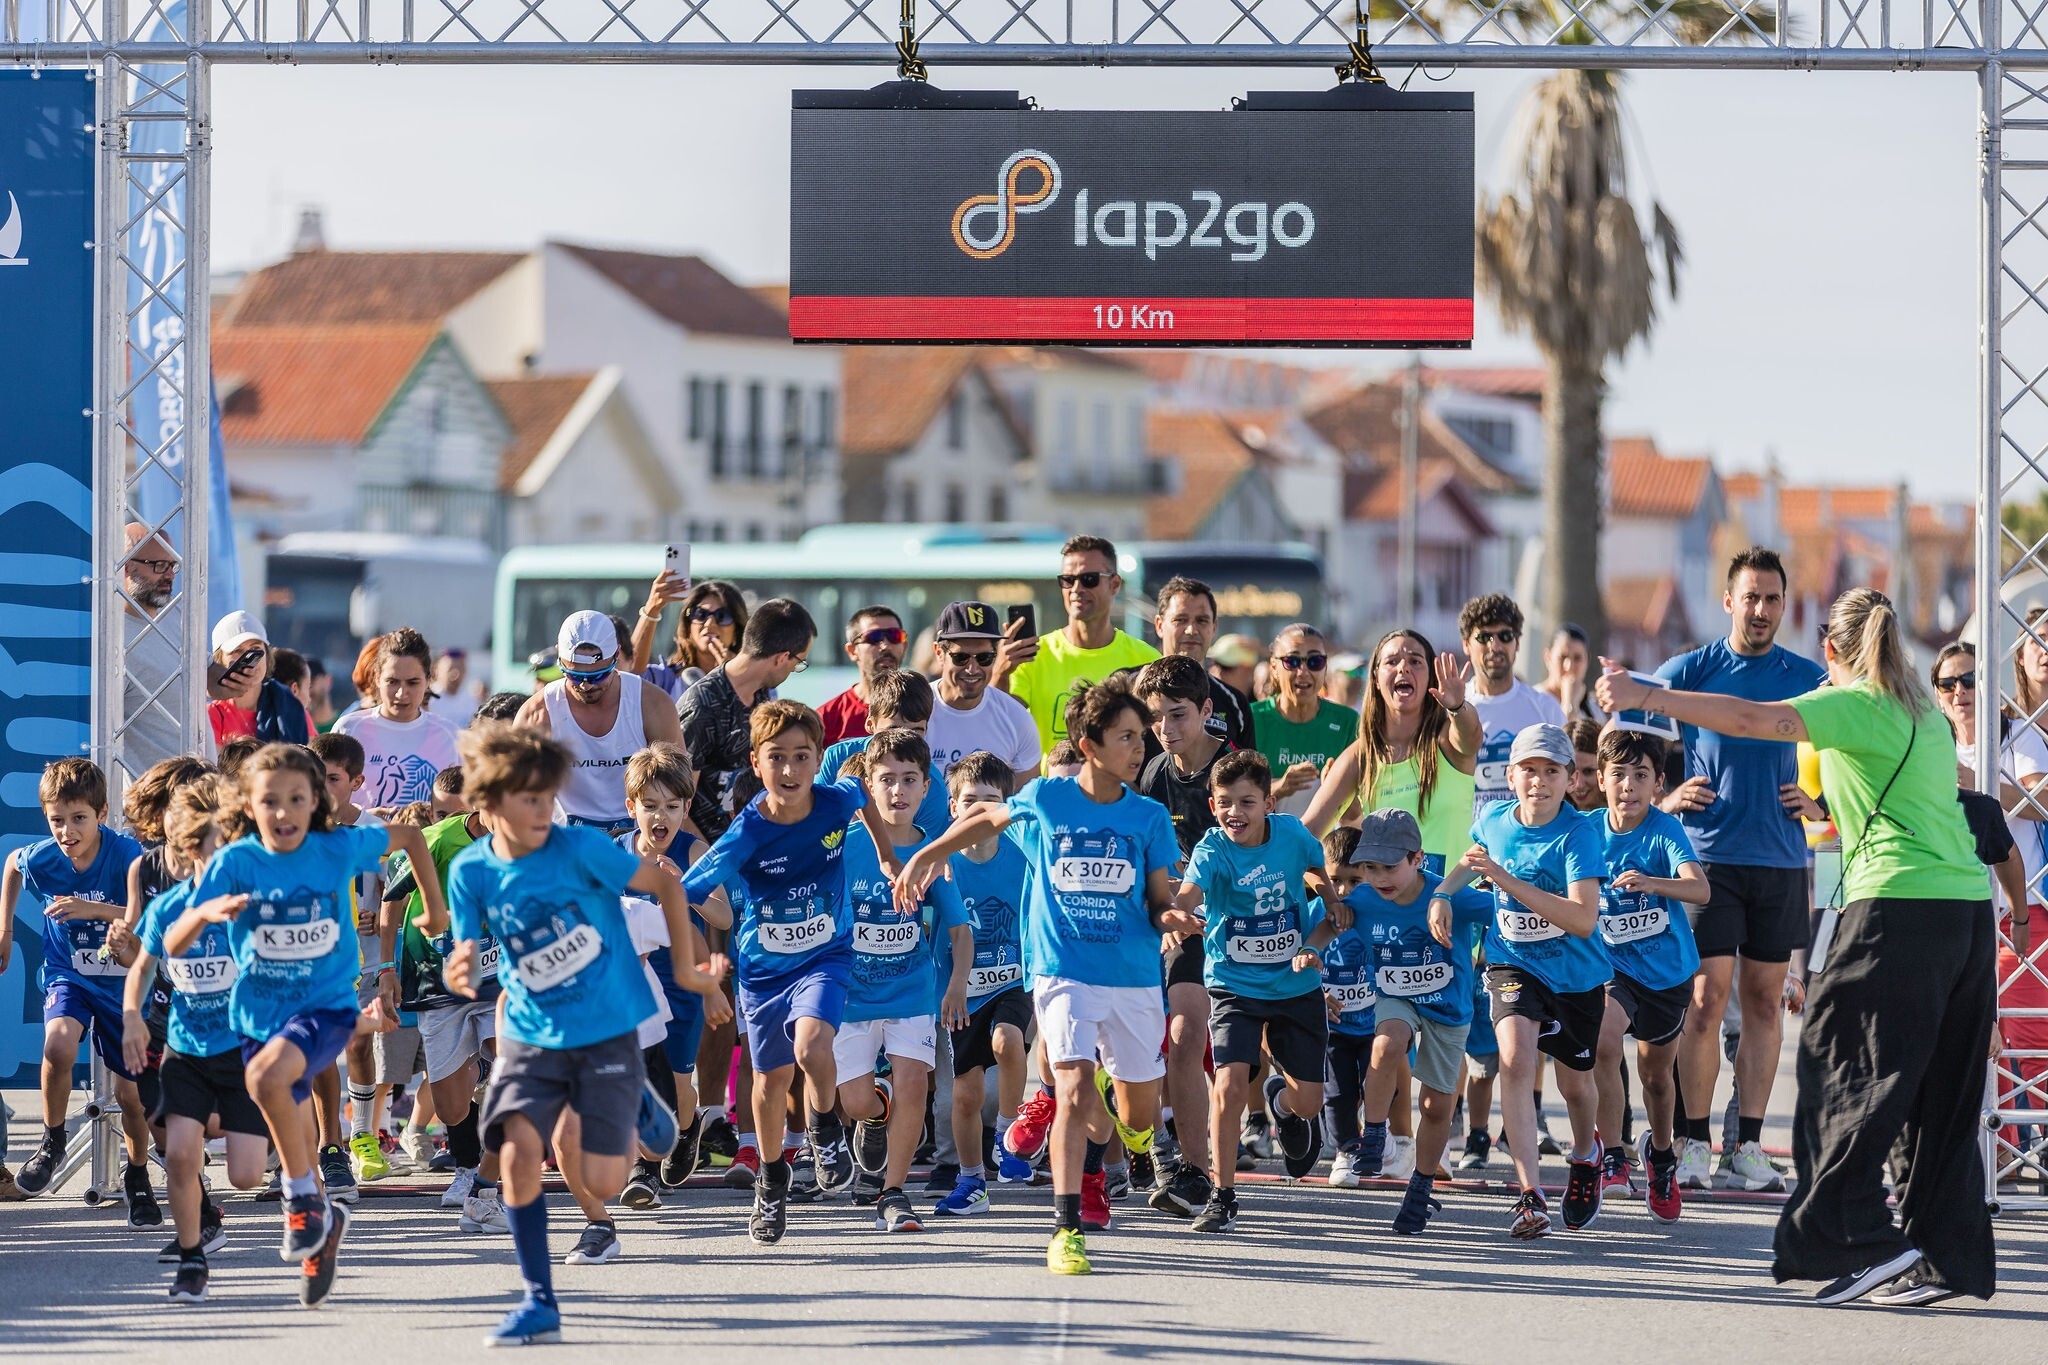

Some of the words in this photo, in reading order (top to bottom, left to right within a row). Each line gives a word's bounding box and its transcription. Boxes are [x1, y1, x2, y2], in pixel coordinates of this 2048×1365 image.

[1074, 188, 1315, 261] lap2go
[1093, 304, 1124, 330] 10
[1131, 304, 1175, 330] Km
[1278, 753, 1325, 765] RUNNER
[1062, 862, 1073, 878] K
[1080, 862, 1126, 879] 3077
[1238, 864, 1266, 887] open
[1253, 871, 1285, 888] primus
[1063, 895, 1117, 910] CORRIDA
[1063, 905, 1117, 922] POPULAR
[1502, 913, 1512, 929] K
[1517, 915, 1550, 930] 306
[1602, 918, 1614, 933] K
[1618, 911, 1659, 932] 3079
[263, 929, 277, 946] K
[284, 923, 329, 946] 3069
[767, 926, 780, 941] K
[784, 917, 826, 942] 3066
[858, 926, 870, 941] K
[875, 925, 914, 943] 3008
[1237, 939, 1249, 952] K
[1255, 933, 1295, 953] 3089
[81, 952, 94, 965] K
[524, 958, 541, 977] K
[541, 931, 588, 970] 3048
[184, 960, 228, 979] 3057
[976, 966, 1017, 985] 3067
[1385, 970, 1396, 984] K
[1401, 966, 1445, 984] 3068
